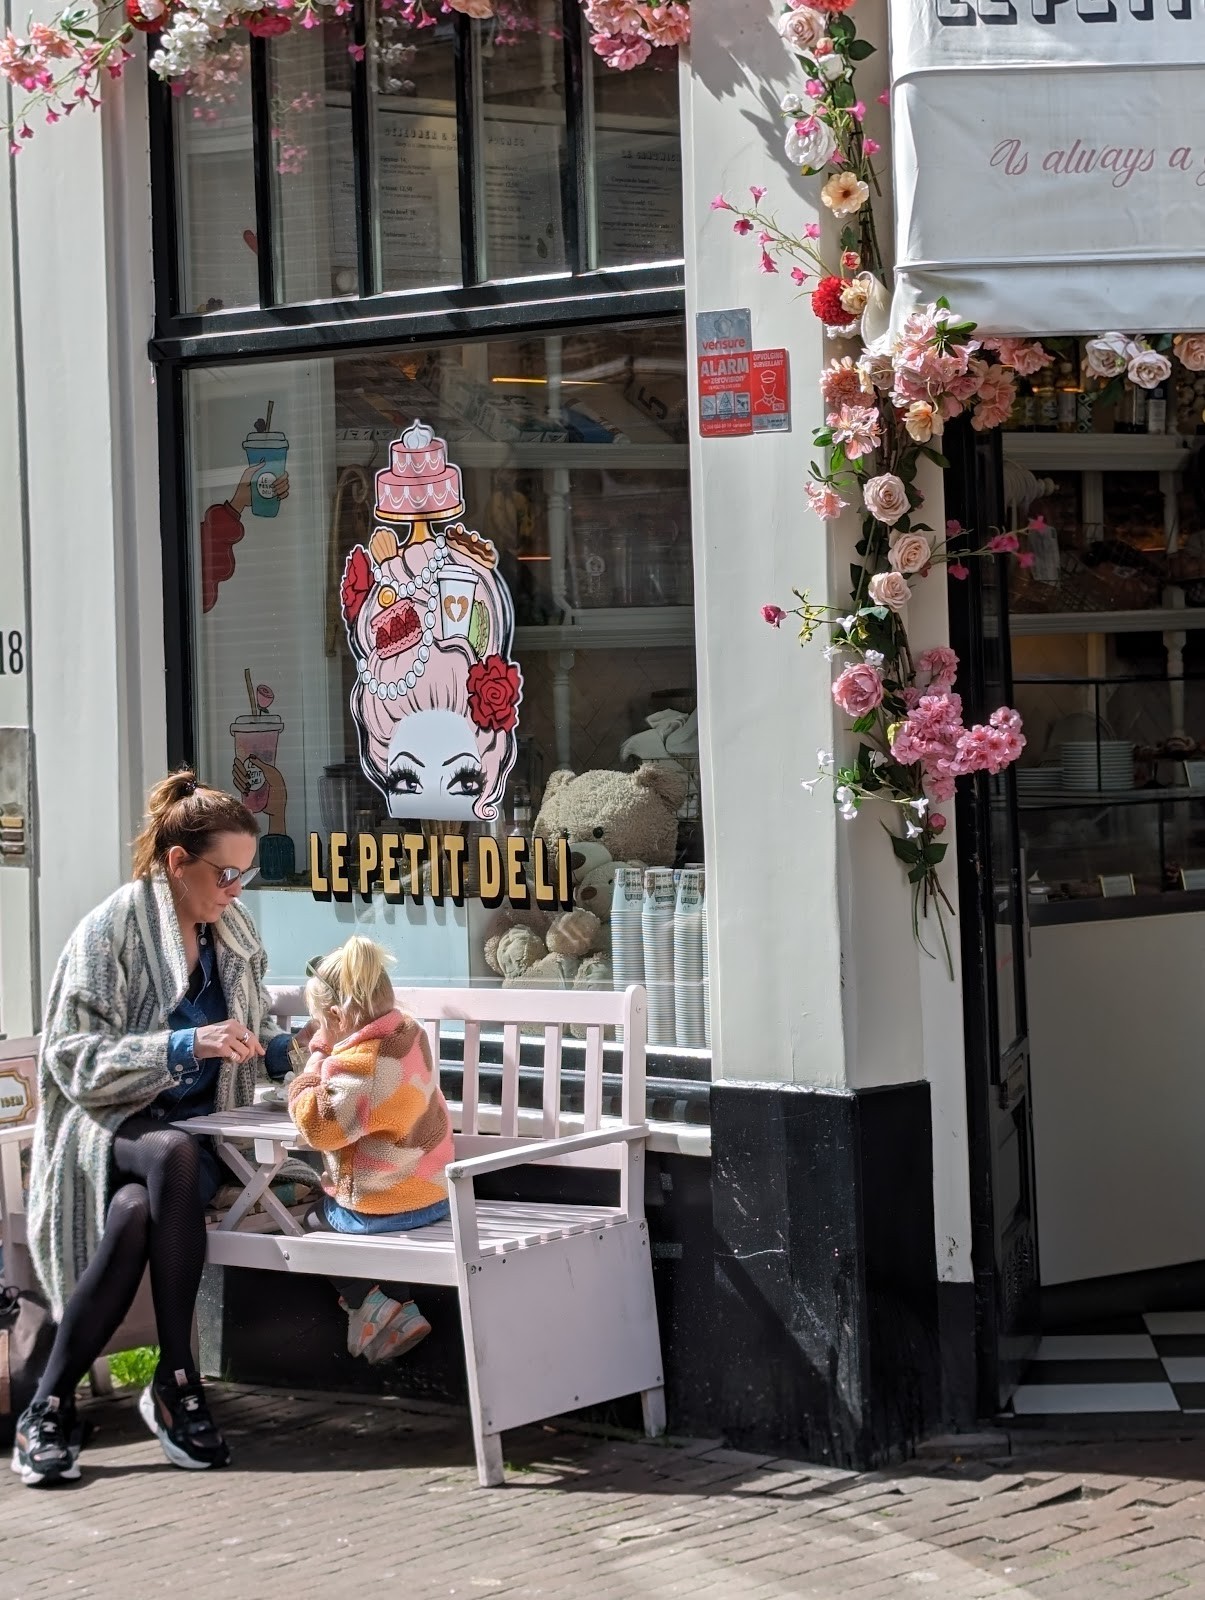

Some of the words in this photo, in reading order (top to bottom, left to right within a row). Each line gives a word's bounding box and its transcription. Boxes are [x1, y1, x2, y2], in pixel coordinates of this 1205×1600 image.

[1042, 138, 1155, 188] always
[1168, 146, 1194, 171] a
[702, 338, 746, 350] verisure
[701, 357, 749, 377] ALARM
[310, 832, 352, 902] LE
[358, 832, 468, 907] PETIT
[478, 836, 573, 912] DELI
